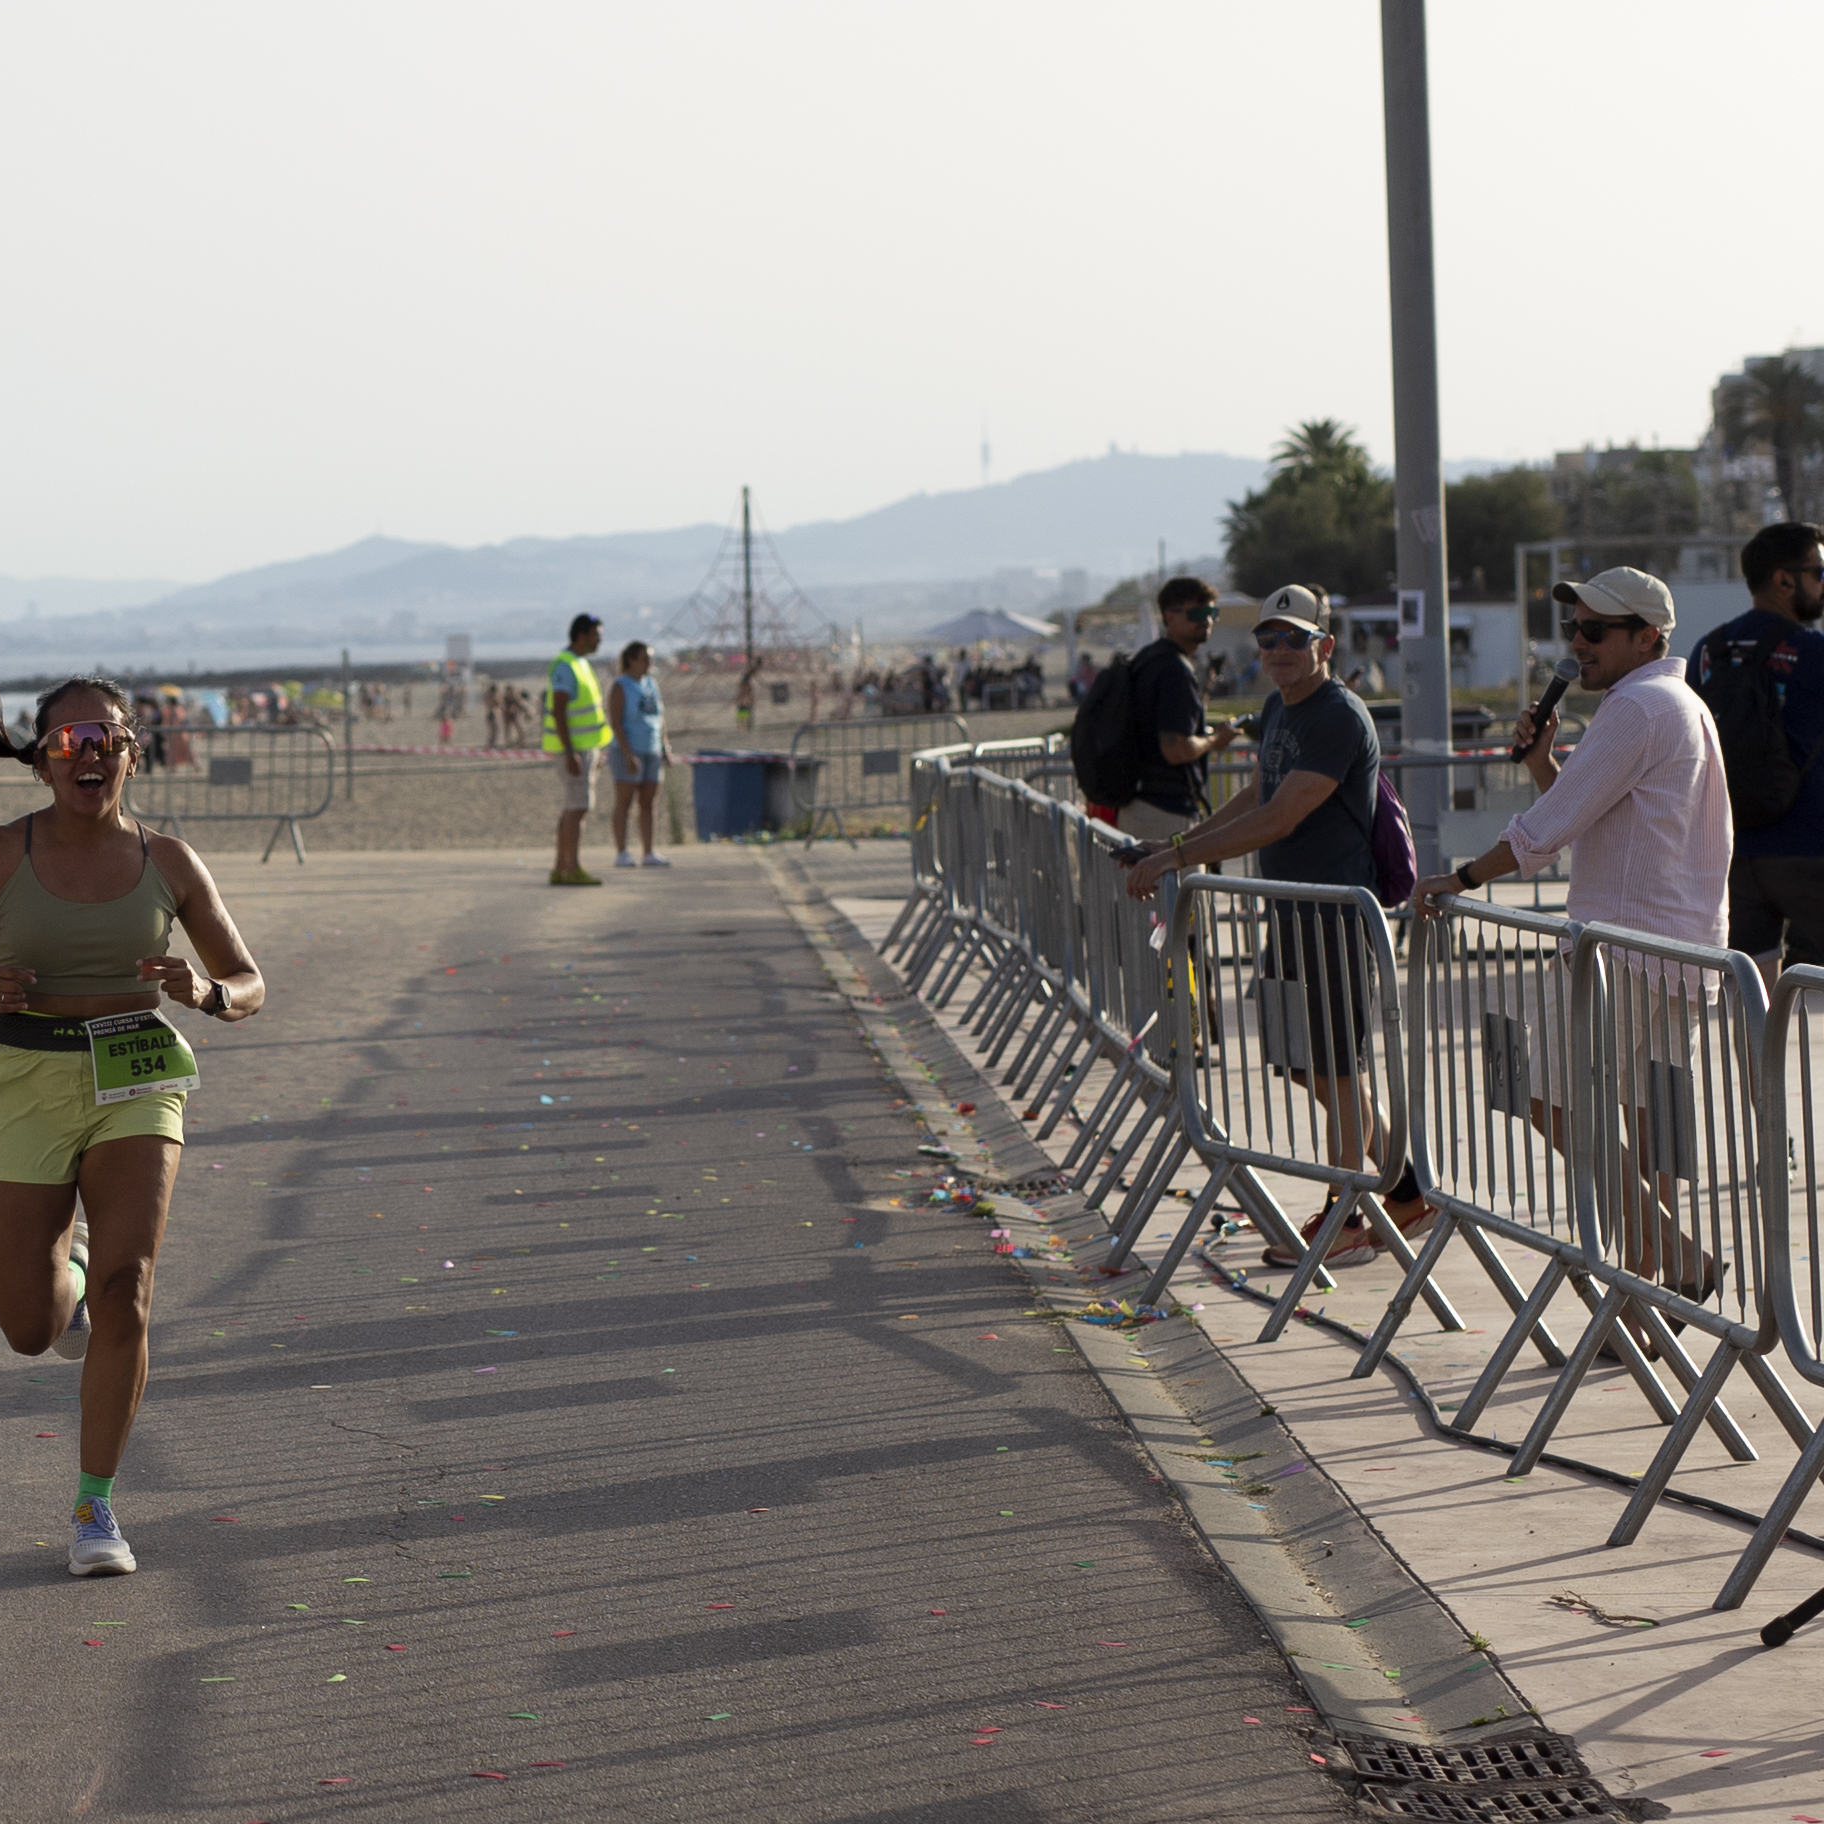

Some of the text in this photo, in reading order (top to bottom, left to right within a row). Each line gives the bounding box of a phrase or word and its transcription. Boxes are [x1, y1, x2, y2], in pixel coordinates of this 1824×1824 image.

[93, 1026, 116, 1036] PREMIÀ
[127, 1023, 140, 1031] MAR
[113, 1017, 133, 1026] CURSA
[108, 1033, 179, 1057] ESTÍBALIZ
[130, 1055, 166, 1077] 534
